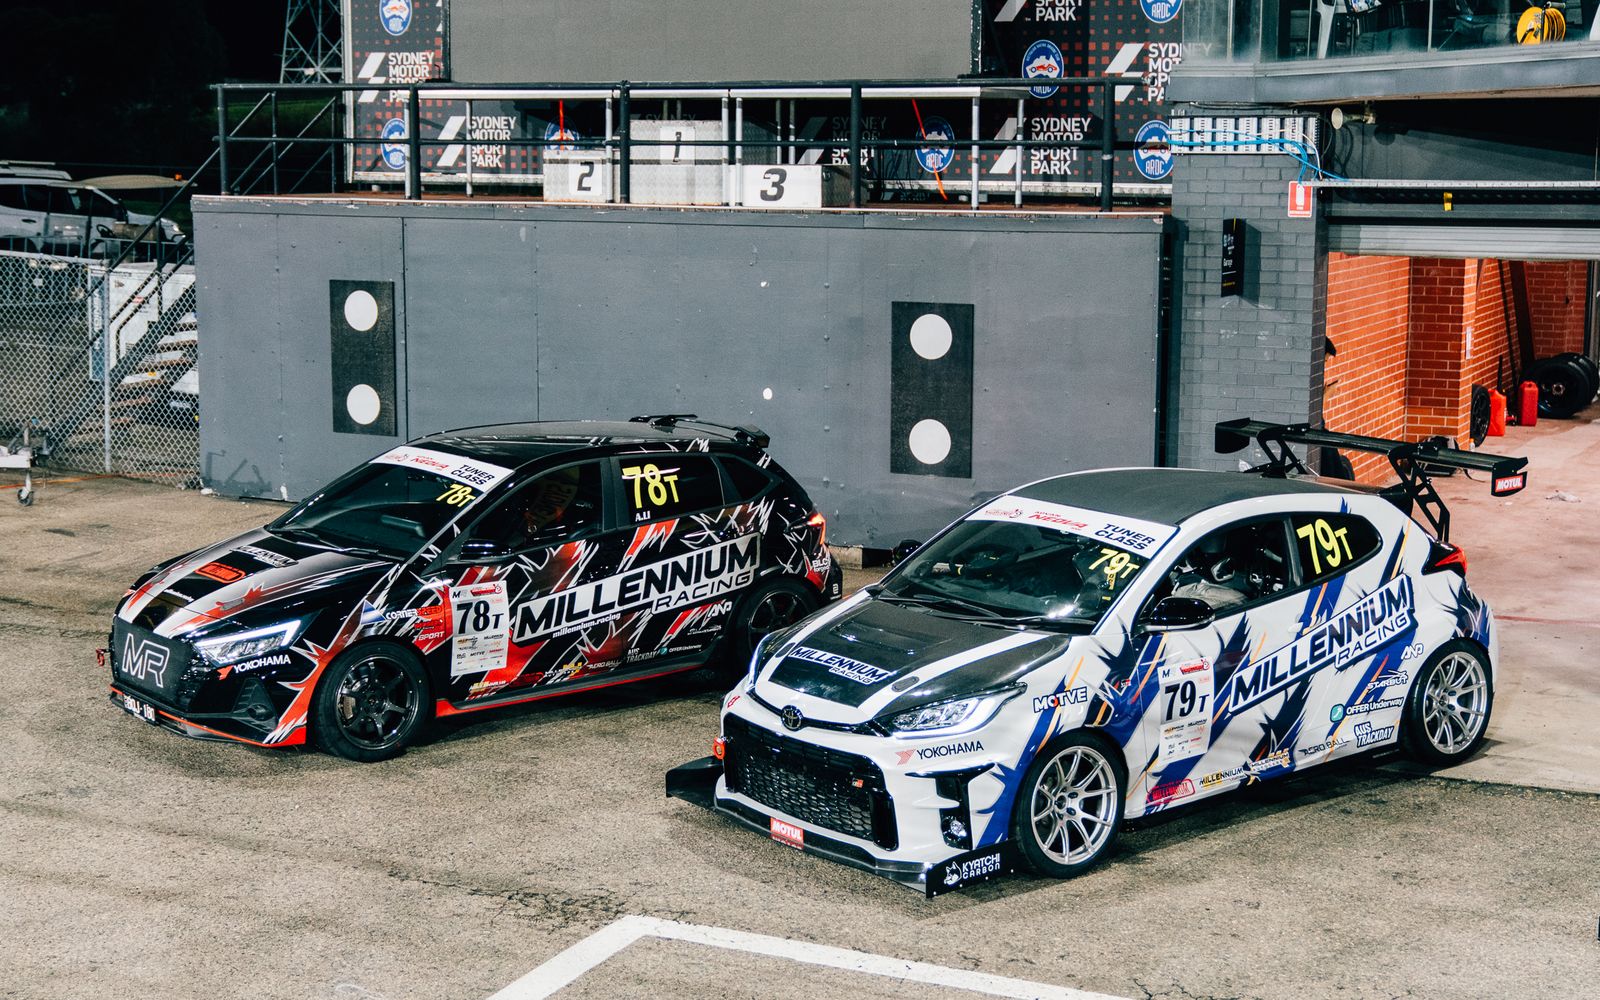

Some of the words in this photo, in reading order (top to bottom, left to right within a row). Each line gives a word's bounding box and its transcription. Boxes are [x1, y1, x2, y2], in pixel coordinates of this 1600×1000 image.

[1035, 6, 1077, 22] PARK
[388, 52, 435, 65] SYDNEY
[388, 65, 430, 78] MOTOR
[1031, 117, 1092, 132] SYDNEY
[1030, 147, 1079, 161] SPORT
[577, 161, 595, 191] 2
[1030, 160, 1072, 175] PARK
[1145, 159, 1165, 175] ARDC
[760, 168, 787, 201] 3
[450, 469, 488, 486] CLASS
[459, 464, 496, 481] TUNER
[621, 464, 680, 509] 78T
[1495, 477, 1523, 491] MOTUL
[436, 483, 476, 508] 78T
[1094, 529, 1149, 550] CLASS
[1104, 523, 1156, 544] TUNER
[1296, 518, 1354, 575] 79T
[1088, 548, 1141, 579] 79T
[516, 536, 759, 639] MILLENNIUM
[655, 574, 752, 613] RACING
[456, 600, 504, 634] 78T
[552, 612, 621, 638] millennium.racing
[1230, 577, 1407, 709] MILLENNIUM
[1337, 612, 1408, 664] RACING
[122, 633, 170, 688] MR
[233, 654, 292, 674] YOKOHAMA
[626, 651, 657, 663] TRACKDAY
[790, 647, 889, 680] MILLENNIUM
[829, 667, 873, 684] RACING
[1164, 680, 1210, 722] 79T
[1346, 702, 1370, 716] OFFER
[1369, 698, 1404, 711] Underway
[1354, 723, 1372, 736] AUS
[1357, 727, 1394, 748] TRACKDAY
[916, 740, 985, 761] YOKOHAMA
[1200, 766, 1244, 787] MILLENNIUM
[772, 820, 801, 840] MOTUL
[962, 852, 1000, 873] KYATCHI
